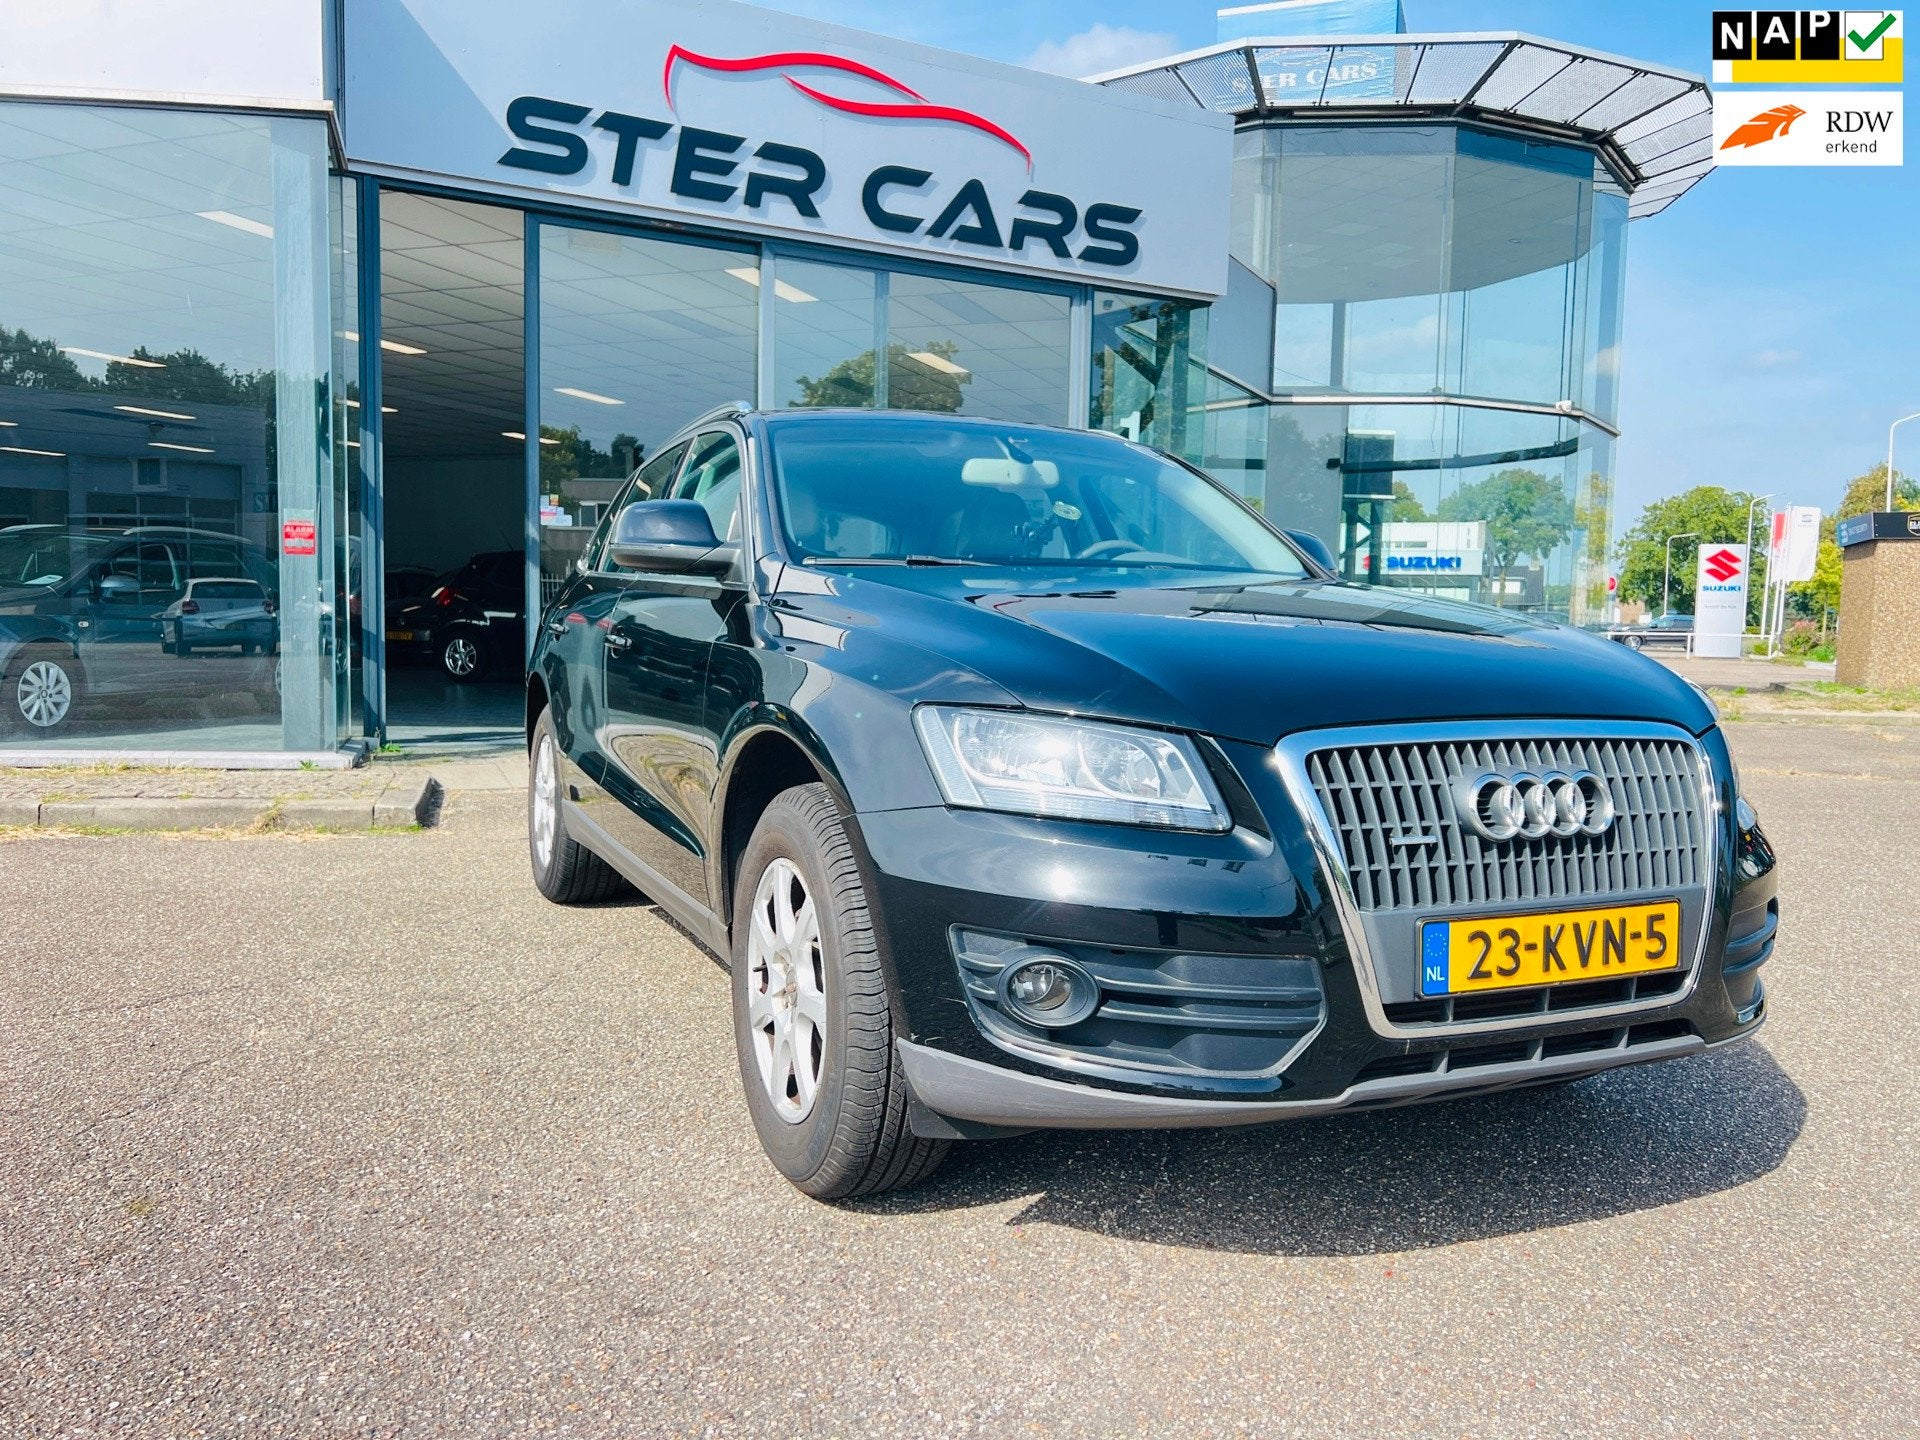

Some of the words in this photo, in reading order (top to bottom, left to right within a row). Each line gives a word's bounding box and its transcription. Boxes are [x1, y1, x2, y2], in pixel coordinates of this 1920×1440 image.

[1306, 61, 1378, 86] CARS
[497, 95, 828, 219] STER
[861, 164, 1144, 268] CARS
[1387, 556, 1462, 570] SUZUKI
[1467, 913, 1668, 981] 23-KVN-5
[1426, 966, 1446, 983] NL
